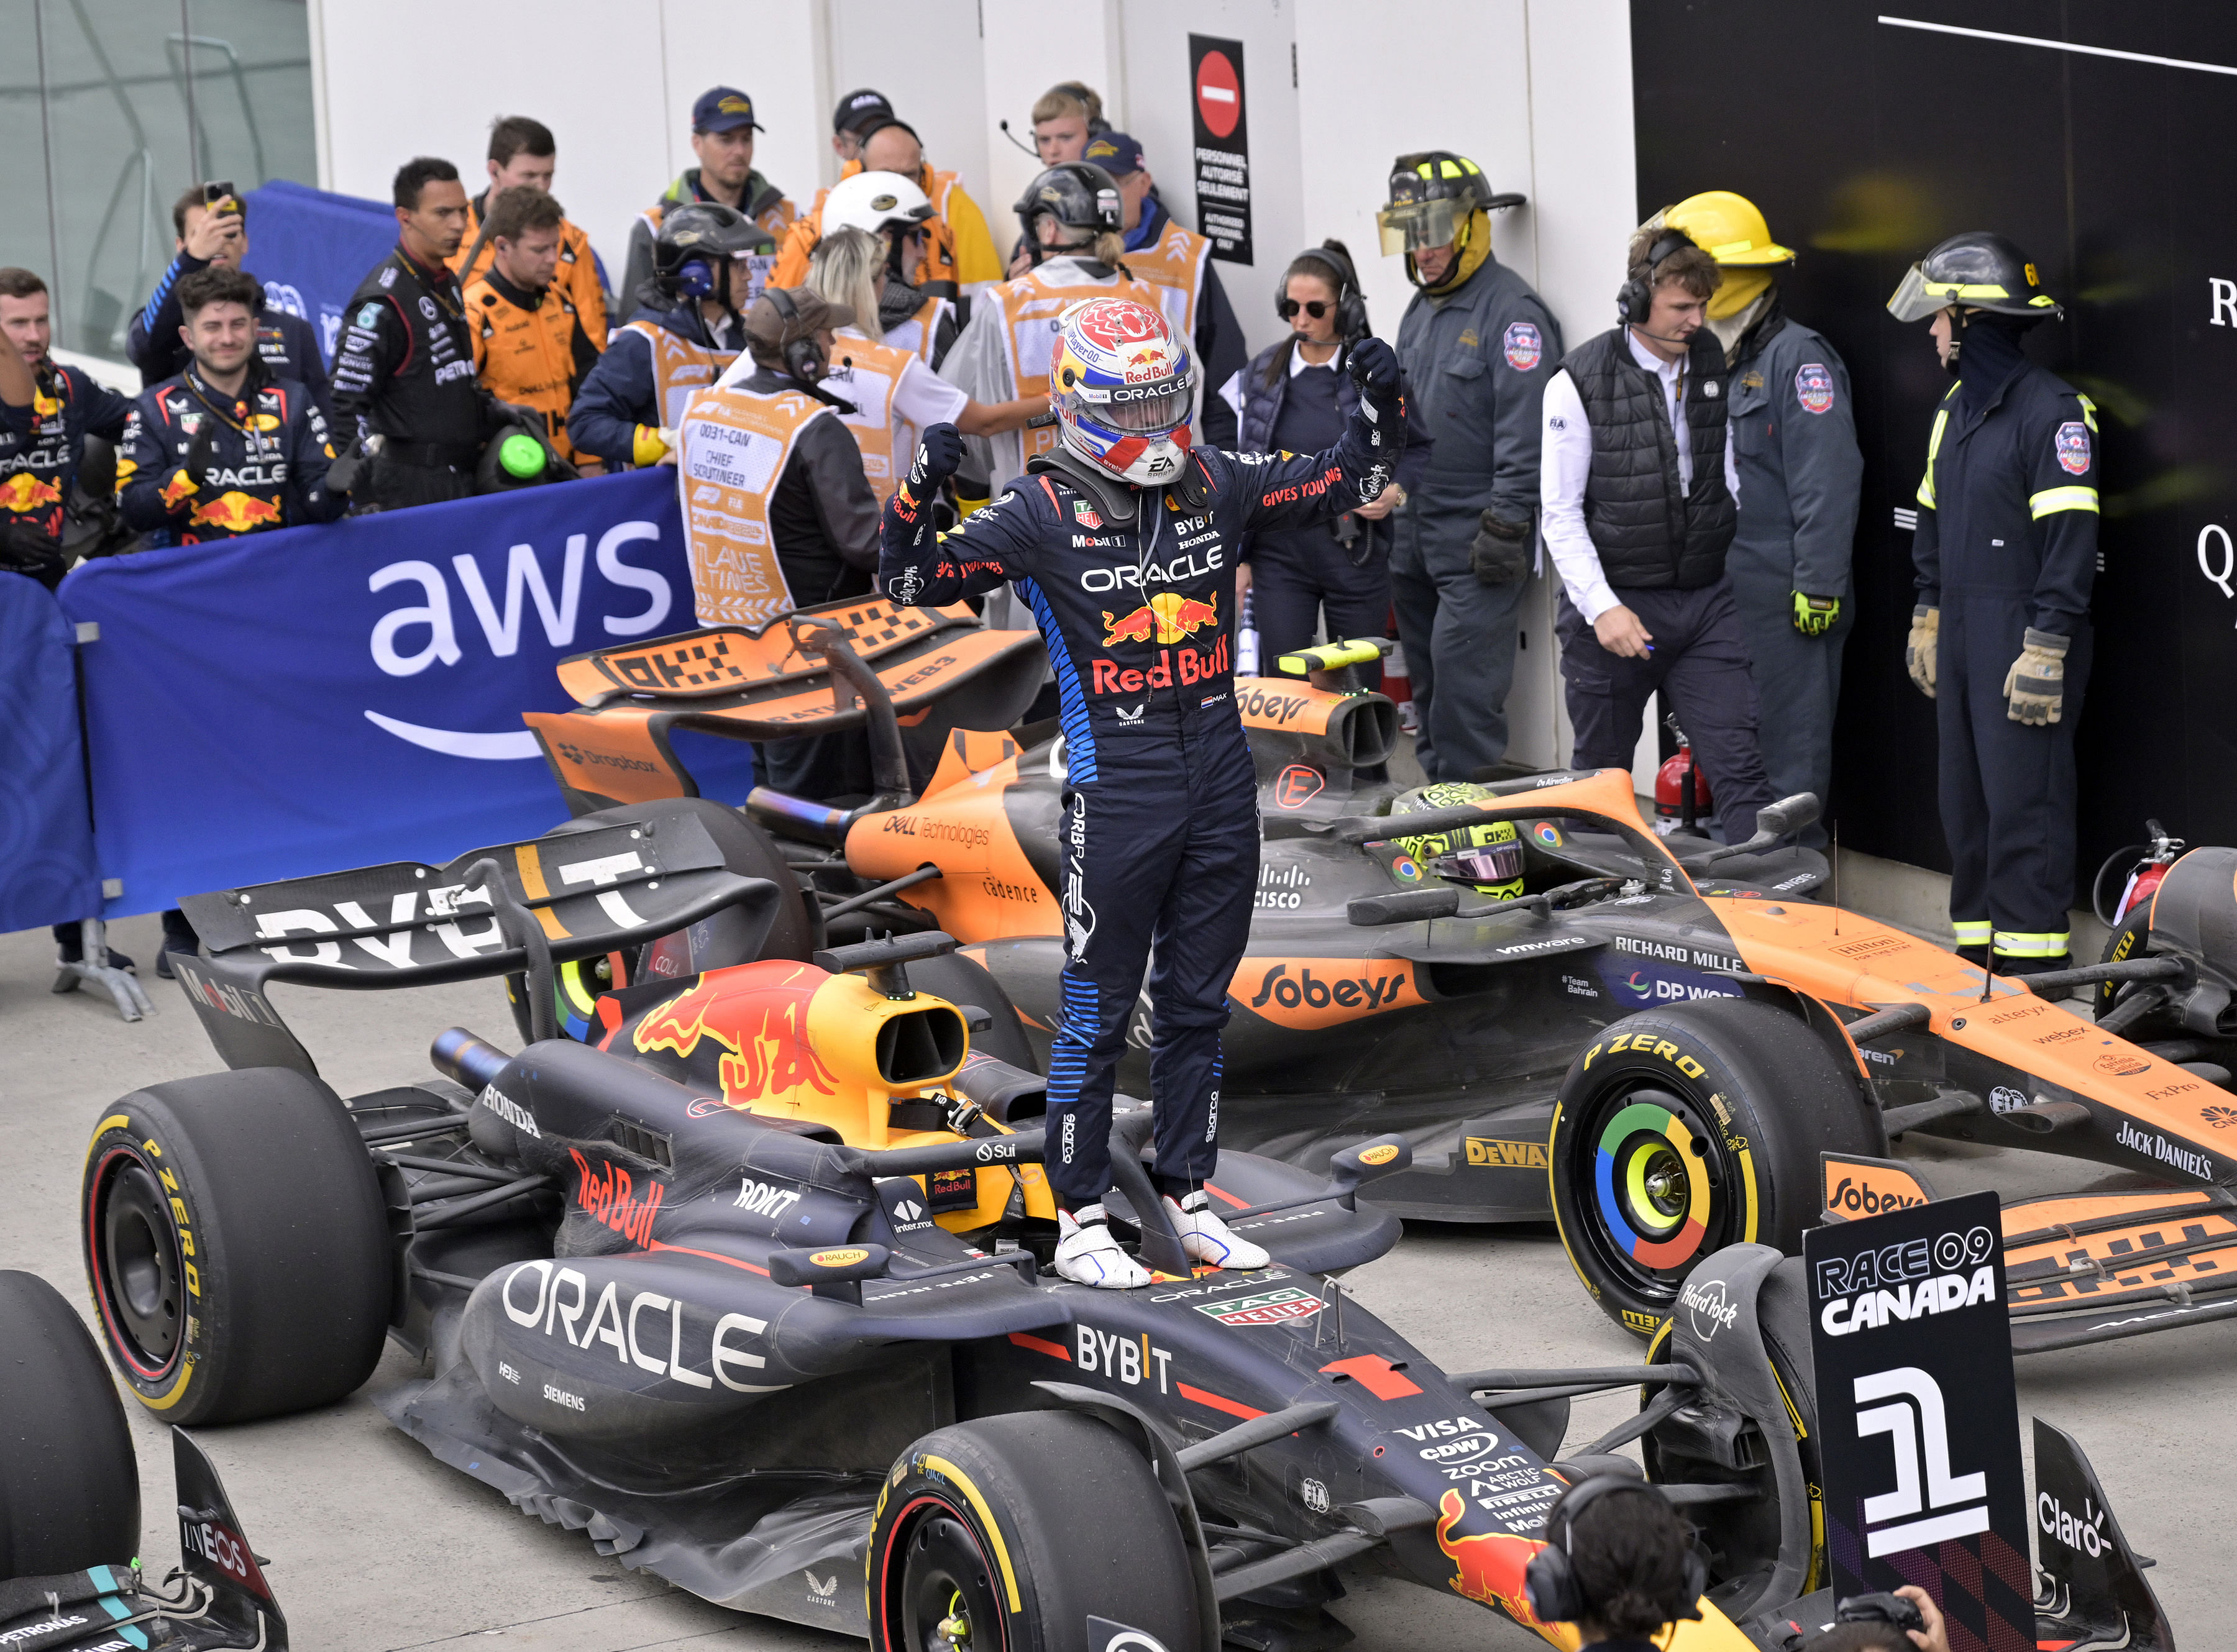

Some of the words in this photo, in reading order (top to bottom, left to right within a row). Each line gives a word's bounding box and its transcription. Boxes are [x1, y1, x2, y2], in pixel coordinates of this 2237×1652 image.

[1068, 330, 1087, 357] Player
[1125, 371, 1151, 384] Red
[1153, 363, 1173, 380] Bull
[1114, 378, 1186, 401] ORACLE
[700, 423, 751, 447] 0031-CAN
[0, 444, 71, 477] RACLE
[706, 450, 733, 468] CHIEF
[1104, 460, 1123, 473] BYBIT
[1149, 457, 1175, 472] EA
[205, 463, 288, 486] RACLE
[693, 463, 746, 488] SCRUTINEER
[1147, 467, 1176, 478] SPORTS
[1263, 486, 1297, 507] GIVES
[1301, 480, 1325, 497] YOU
[894, 501, 917, 524] Bull
[1072, 535, 1111, 547] Mobil
[1178, 531, 1220, 550] HONDA
[1081, 544, 1224, 592] ORACLE
[368, 521, 672, 677] aws
[1091, 649, 1173, 695] Red
[1178, 633, 1229, 686] Bull
[1213, 692, 1227, 702] MAX
[584, 749, 661, 774] Dropbox
[883, 815, 918, 836] DELL
[919, 816, 989, 849] Technologies
[1496, 936, 1586, 956] vmware
[1616, 936, 1688, 962] RICHARD
[1693, 951, 1742, 972] MILLE
[1839, 938, 1895, 955] Hilton
[1854, 952, 1872, 961] FOR
[1891, 944, 1912, 954] STAY
[655, 956, 679, 976] COLA
[176, 963, 250, 1022] Mobil
[1252, 964, 1405, 1010] Sobeys
[1562, 975, 1589, 987] #Team
[1568, 985, 1598, 997] Bahrain
[1656, 980, 1685, 1001] DP
[1988, 1003, 2050, 1025] alteryx
[2034, 1026, 2090, 1046] webex
[1584, 1043, 1602, 1071] P
[1608, 1033, 1706, 1079] ZERO
[1858, 1047, 1895, 1066] aren
[2100, 1056, 2136, 1069] Estrella
[2144, 1083, 2200, 1101] FxPro
[482, 1083, 542, 1139] HONDA
[1205, 1091, 1219, 1143] sparco
[994, 1143, 1016, 1158] Sui
[1062, 1113, 1076, 1164] sparco
[2116, 1120, 2154, 1157] JACK
[2155, 1134, 2212, 1181] DANIEL'S
[1368, 1145, 1395, 1162] RAUCH
[1466, 1139, 1549, 1166] DEWA
[568, 1146, 613, 1225] Red
[608, 1166, 664, 1249] Bull
[935, 1183, 953, 1195] Red
[953, 1180, 971, 1190] Bull
[143, 1139, 162, 1157] P
[158, 1167, 201, 1297] ZERO
[894, 1220, 934, 1234] inter.mx
[825, 1250, 861, 1262] RAUCH
[1816, 1237, 1930, 1300] RACE
[1934, 1226, 1993, 1270] 09
[936, 1272, 994, 1288] PEPE
[1150, 1273, 1291, 1303] ORACLE
[866, 1286, 933, 1301] JEANS
[1207, 1289, 1304, 1313] TAG
[1681, 1284, 1713, 1313] Hard
[1821, 1265, 1996, 1337] CANADA
[1226, 1298, 1323, 1325] HEUER
[502, 1259, 794, 1393] ORACLE
[1077, 1323, 1172, 1395] BYBIT
[1319, 1354, 1424, 1400] 1
[543, 1383, 586, 1412] SIEMENS
[1393, 1416, 1483, 1441] VISA
[1419, 1438, 1481, 1461] CDW
[1854, 1366, 1990, 1559] 1
[1490, 1467, 1540, 1485] ARCTIC
[1500, 1475, 1542, 1490] WOLF
[1303, 1481, 1329, 1510] FIA
[1478, 1484, 1563, 1510] PIRELLI
[2038, 1491, 2104, 1558] Claro
[183, 1522, 247, 1577] INEOS
[807, 1595, 836, 1607] CASTORE
[0, 1615, 88, 1645] PETRONAS
